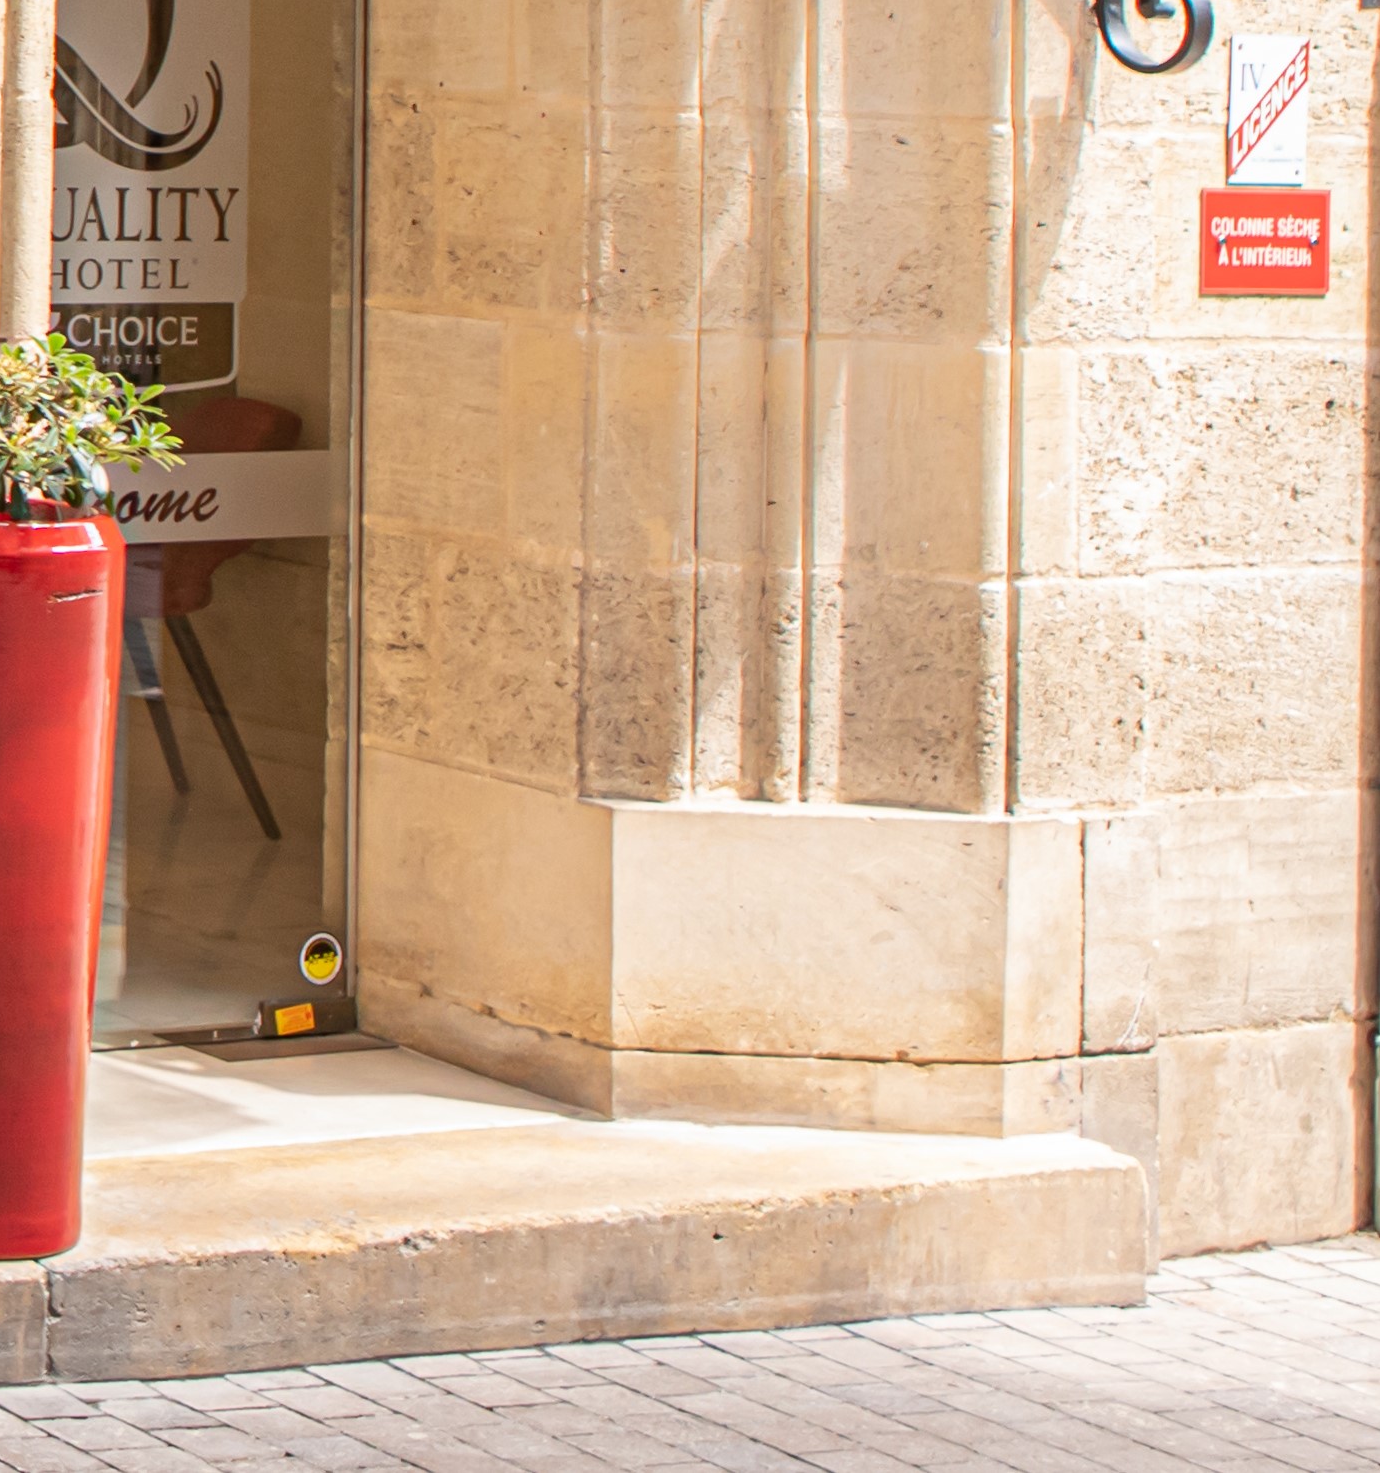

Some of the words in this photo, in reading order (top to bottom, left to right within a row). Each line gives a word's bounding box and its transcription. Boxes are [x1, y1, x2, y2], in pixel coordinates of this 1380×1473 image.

[1231, 47, 1308, 172] LICENCE
[51, 186, 239, 243] UALITY
[1210, 216, 1275, 237] COLONNE
[67, 314, 199, 346] CHOICE
[102, 353, 163, 365] HOTELS
